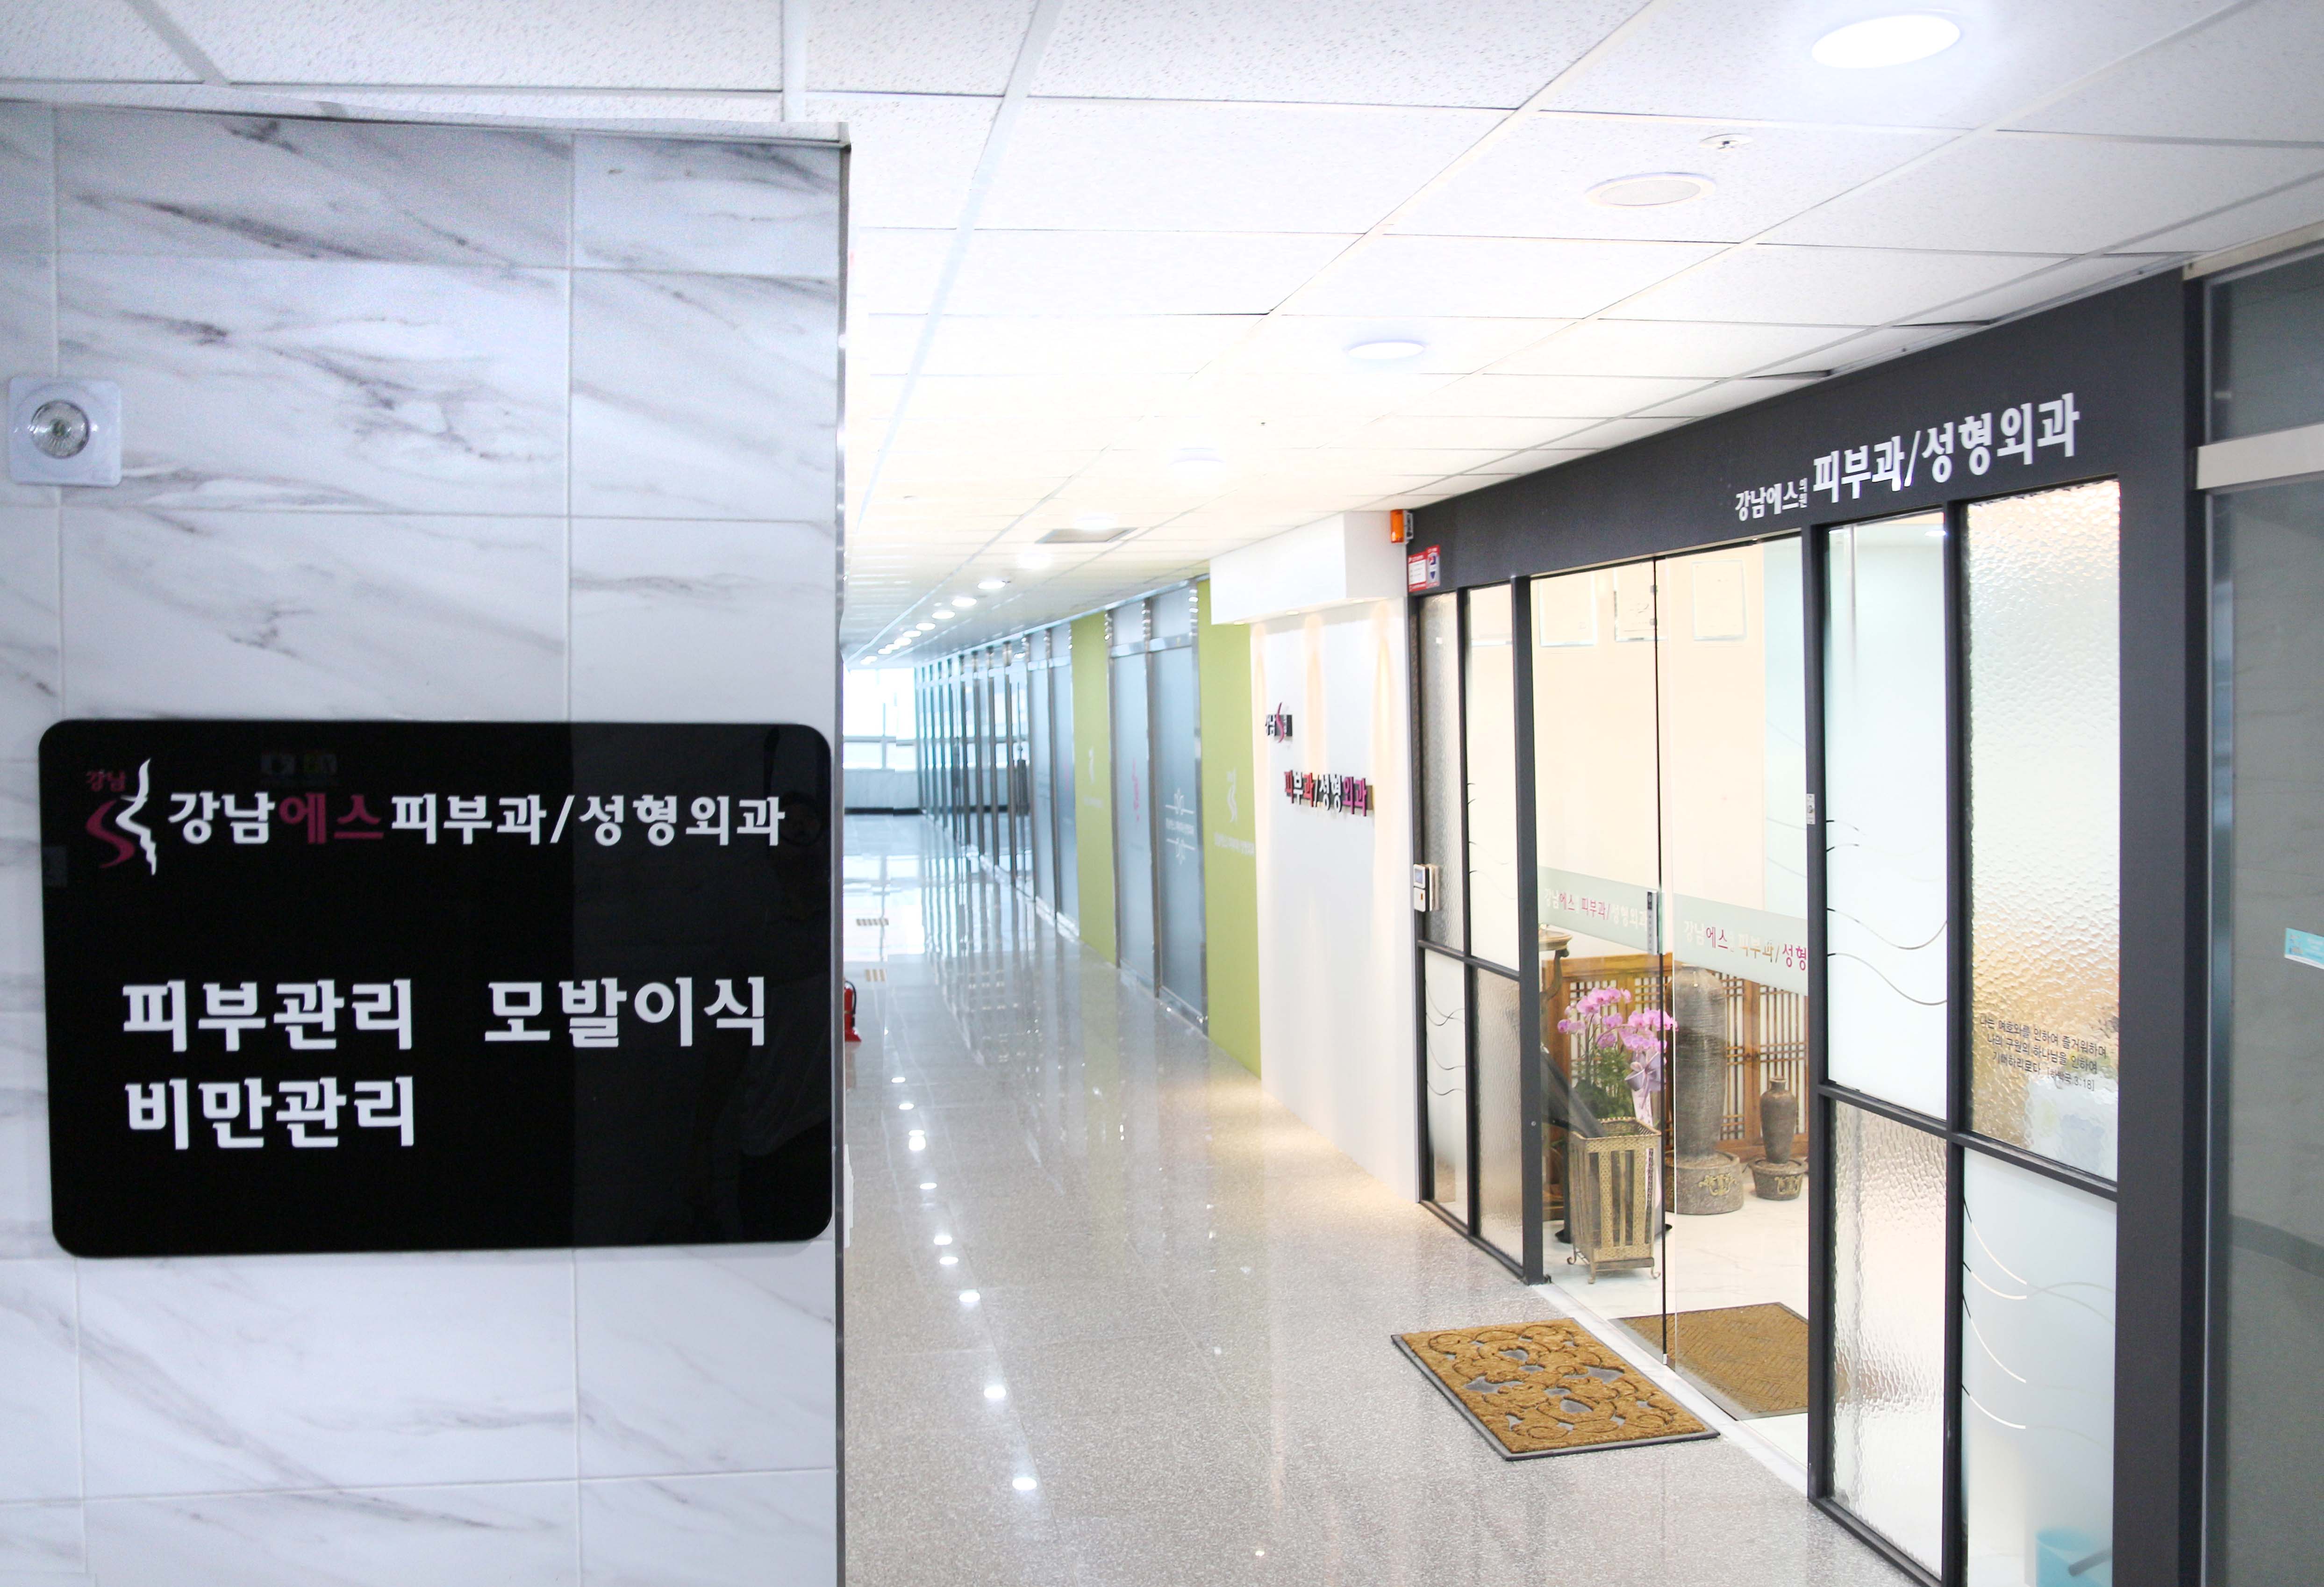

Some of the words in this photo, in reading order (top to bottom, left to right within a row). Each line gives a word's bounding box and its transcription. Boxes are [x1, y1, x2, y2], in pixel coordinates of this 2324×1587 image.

[1735, 481, 1799, 521] 강남에스
[1813, 393, 2080, 503] 피부과/성형외과
[86, 770, 126, 792] 강남
[1284, 769, 1367, 816] 피부과/성형외과
[1545, 888, 1575, 910] 강남에스
[1683, 920, 1728, 949] 강남에스
[122, 979, 412, 1053] 피부관리
[485, 977, 765, 1048] 모발이식
[1980, 1013, 1995, 1029] 나는
[1998, 1020, 2031, 1039] 여호와를
[2034, 1027, 2059, 1046] 인하여
[2063, 1035, 2106, 1059] 즐거워하며
[1988, 1034, 2002, 1047] 나의
[2006, 1038, 2030, 1055] 구원의
[2033, 1045, 2067, 1066] 하나님을
[2071, 1056, 2097, 1074] 인하여
[2075, 1076, 2095, 1092] 3:18]
[125, 1076, 414, 1150] 비만관리
